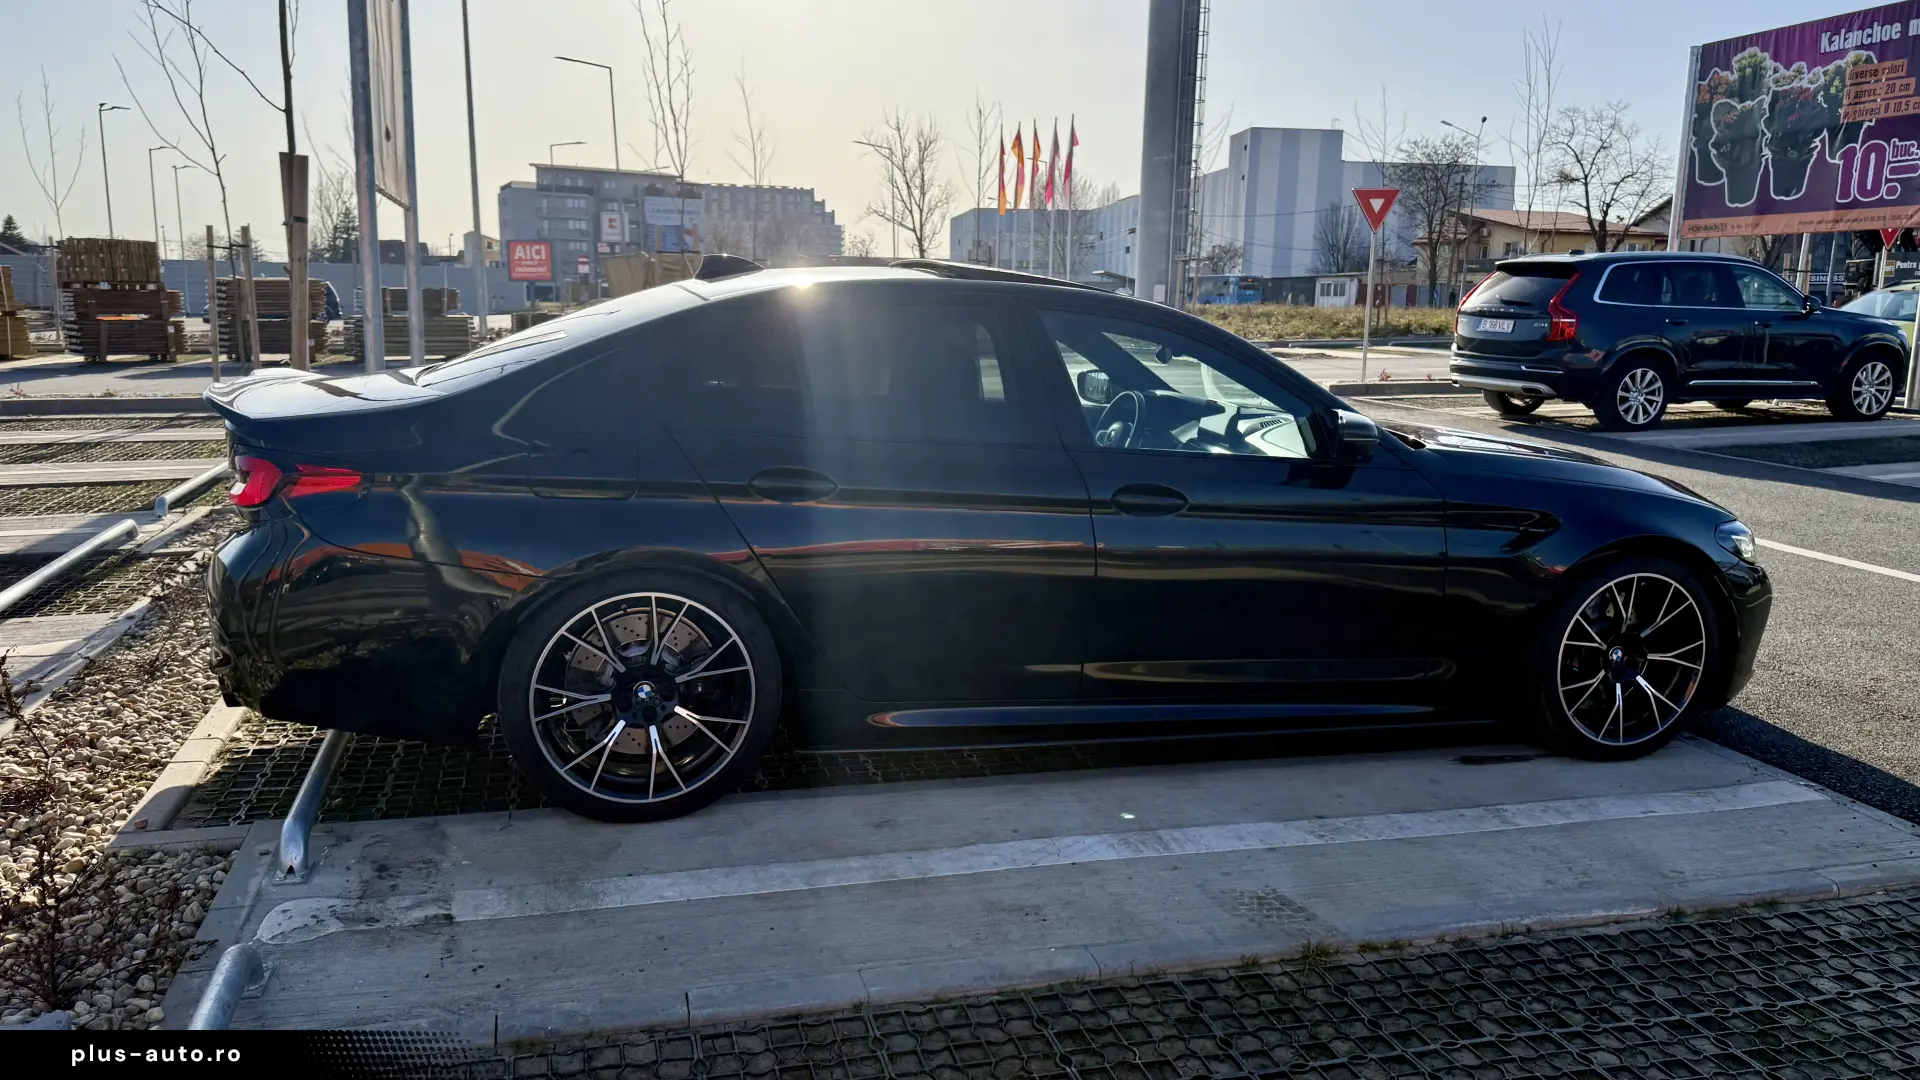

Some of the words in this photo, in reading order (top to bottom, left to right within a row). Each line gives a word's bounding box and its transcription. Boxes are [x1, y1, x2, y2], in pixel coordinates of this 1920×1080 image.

[1820, 21, 1902, 54] Kalanchoe
[1847, 66, 1879, 81] diverse
[1885, 82, 1897, 95] 20
[1898, 82, 1911, 94] cm
[1851, 104, 1881, 121] ghiveci
[1893, 100, 1911, 114] 10,5
[1889, 137, 1920, 162] buc.
[514, 244, 546, 260] AICI
[1482, 320, 1488, 329] B
[1498, 321, 1512, 332] VLV
